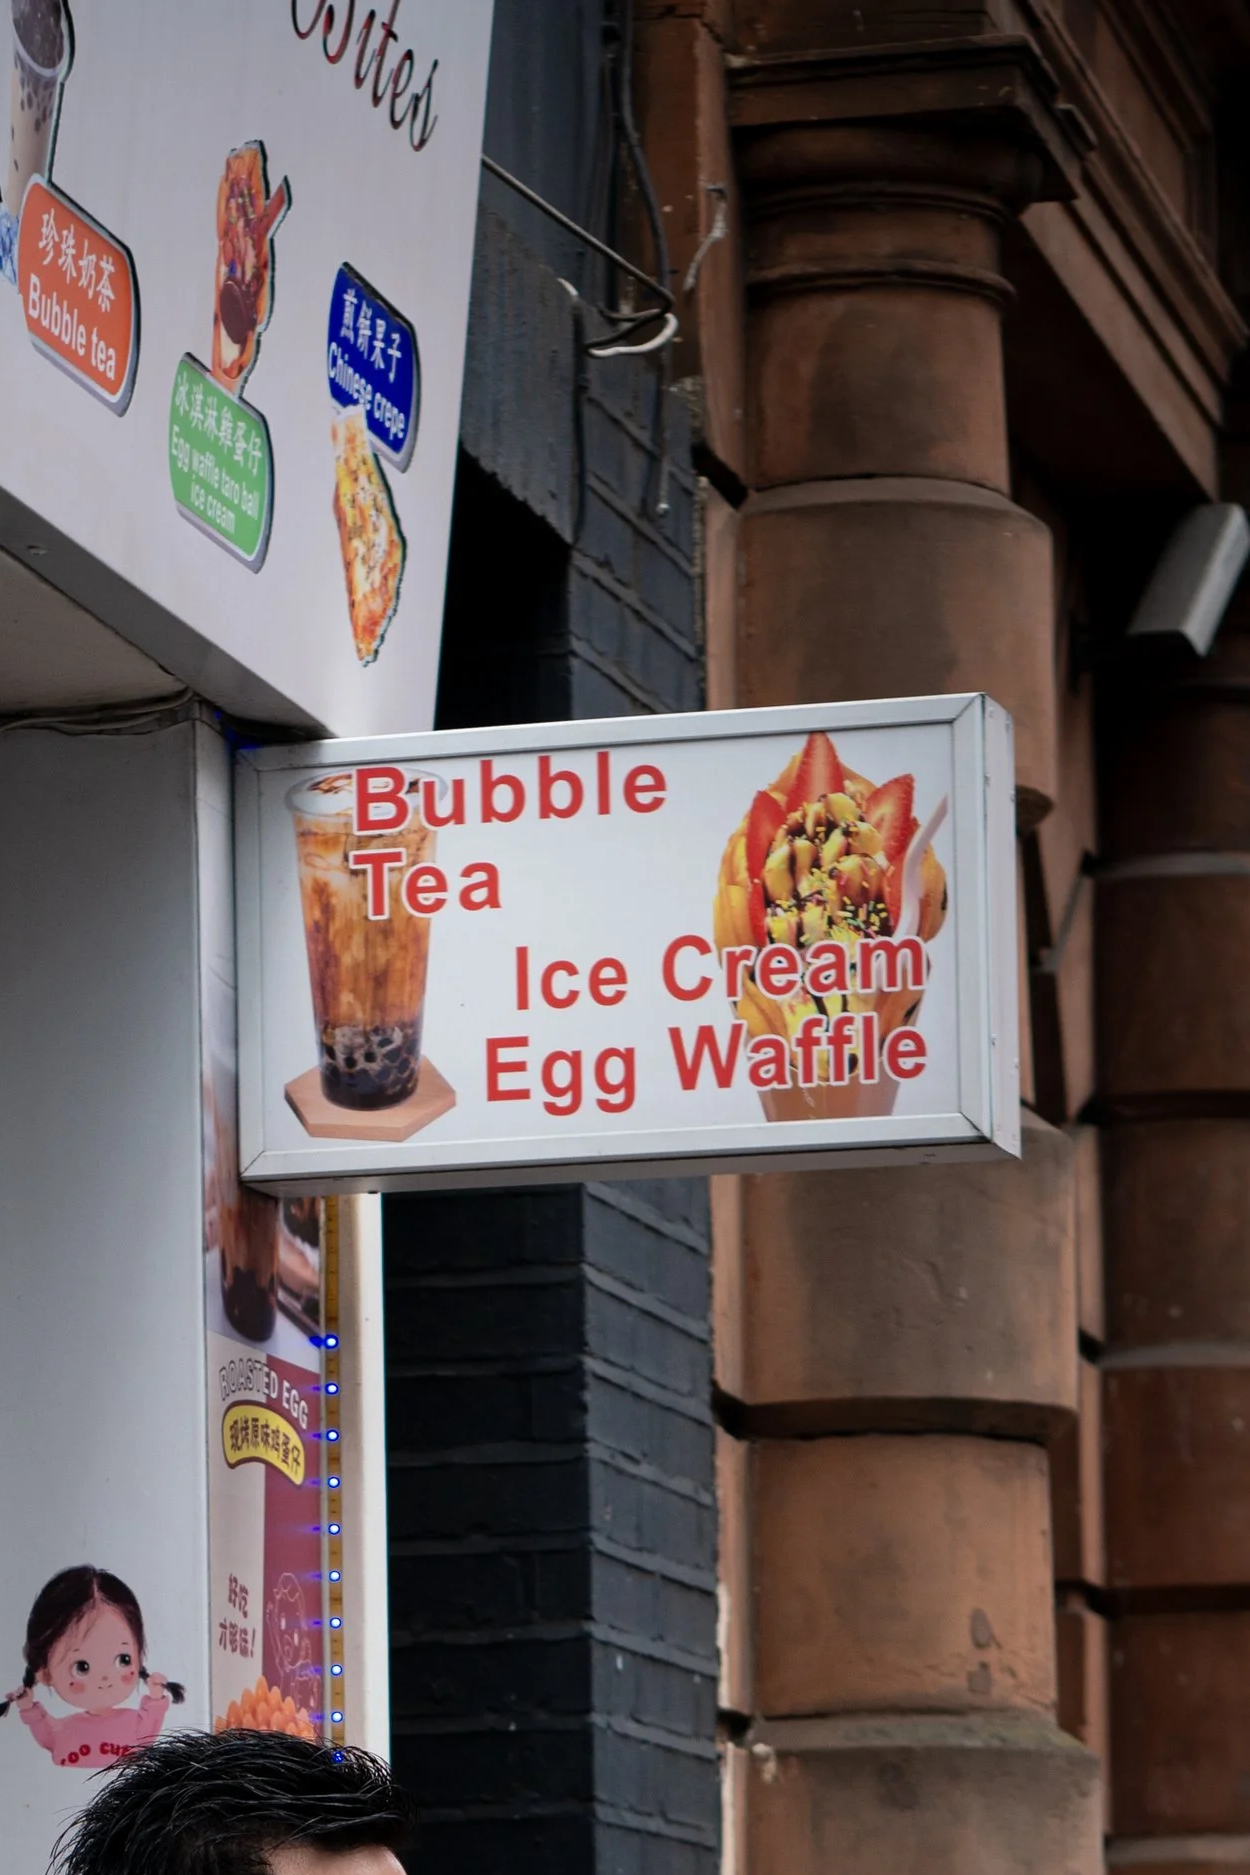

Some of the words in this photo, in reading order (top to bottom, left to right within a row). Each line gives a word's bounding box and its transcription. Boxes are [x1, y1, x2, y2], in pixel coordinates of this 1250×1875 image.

[38, 207, 116, 312] 珍珠奶茶
[28, 273, 87, 357] Bubble
[91, 327, 116, 380] tea
[328, 342, 372, 410] Chinese
[373, 392, 405, 439] crepe
[171, 424, 191, 473] Egg
[192, 448, 220, 488] waffle
[221, 469, 240, 505] taro
[241, 481, 259, 520] ball
[190, 474, 205, 510] ice
[206, 492, 236, 534] cream
[354, 751, 667, 833] Bubble
[353, 850, 502, 918] Tea
[516, 945, 629, 1011] Ice
[662, 934, 927, 1002] Cream
[486, 1036, 636, 1117] Egg
[668, 1016, 928, 1092] Waffle
[219, 1357, 279, 1401] ROASTED
[282, 1379, 309, 1430] EGG
